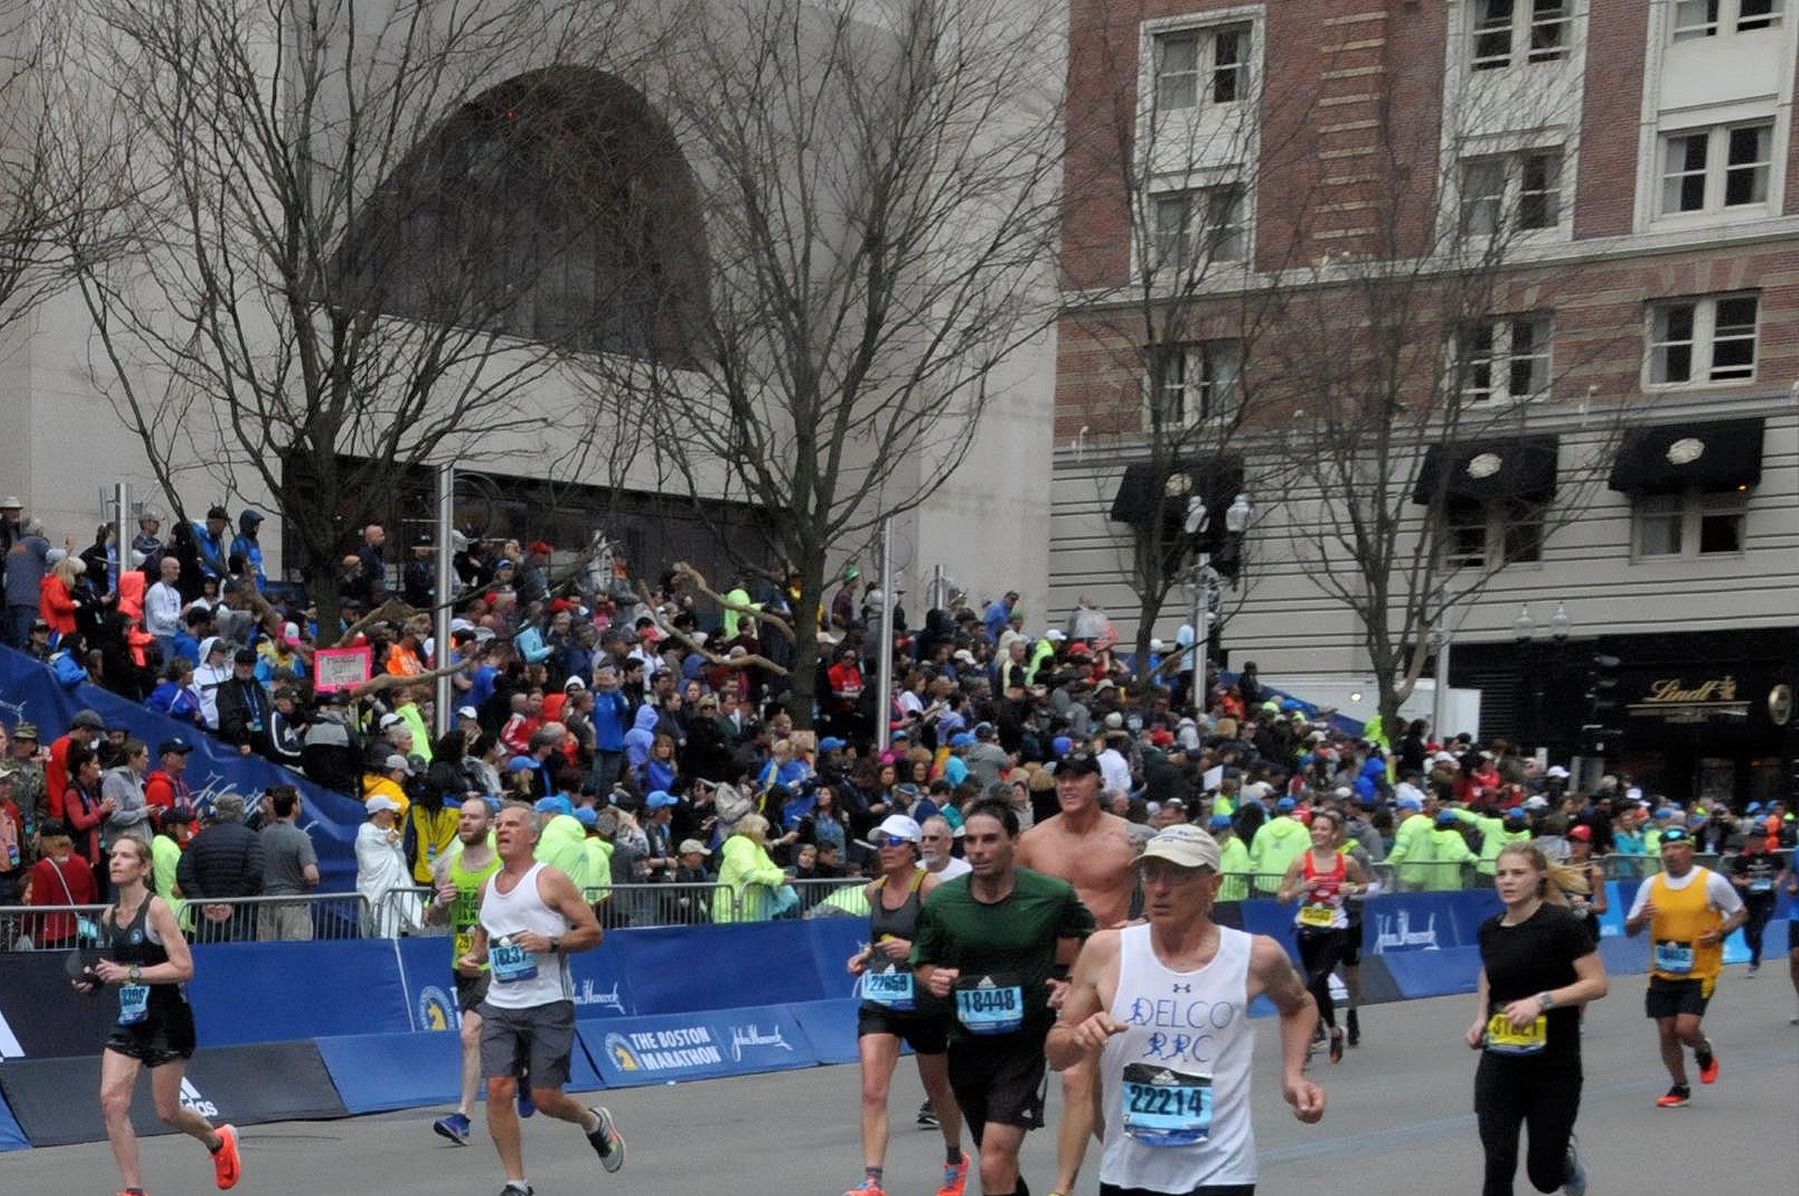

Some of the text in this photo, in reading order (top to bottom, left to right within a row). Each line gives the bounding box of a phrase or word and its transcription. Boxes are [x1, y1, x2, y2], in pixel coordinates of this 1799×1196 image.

[963, 988, 1016, 1013] 18448
[1125, 997, 1234, 1030] DELCO
[630, 1026, 711, 1050] THE BOSTON
[639, 1046, 722, 1071] MARATHON
[1130, 1084, 1204, 1118] 22214
